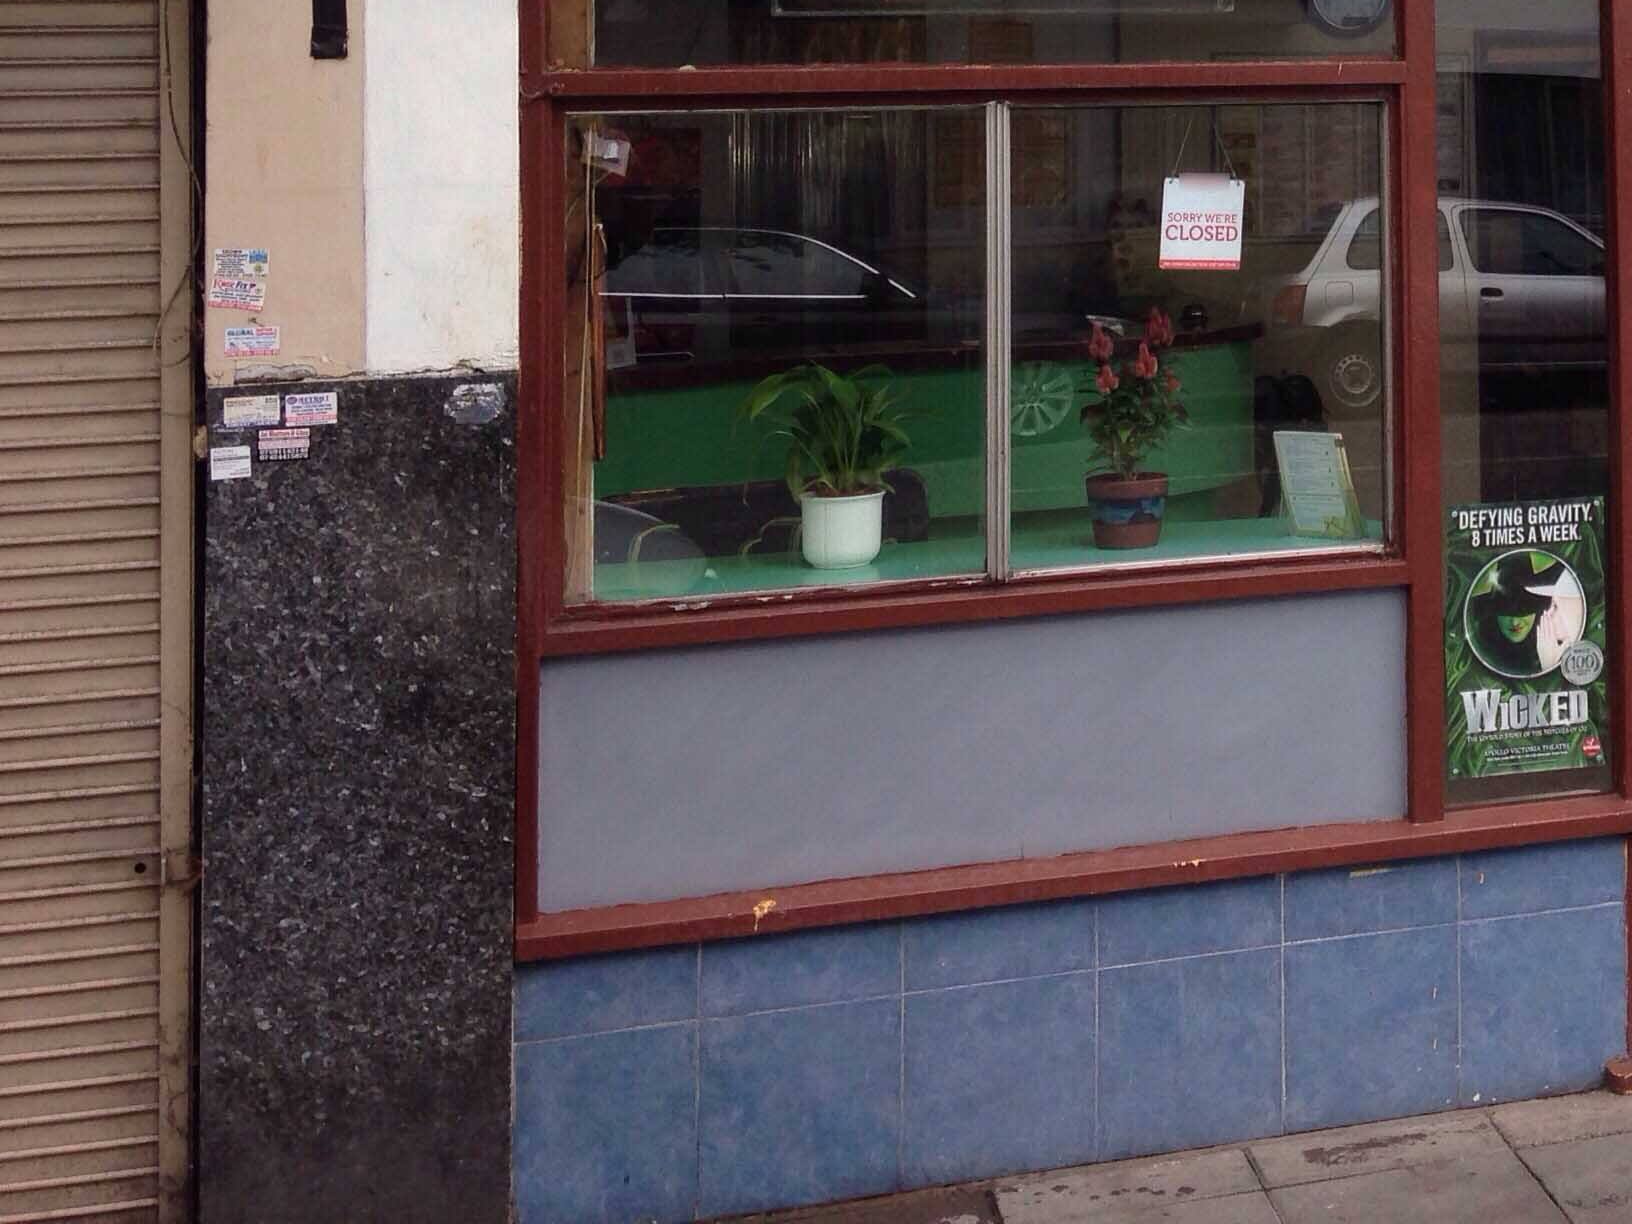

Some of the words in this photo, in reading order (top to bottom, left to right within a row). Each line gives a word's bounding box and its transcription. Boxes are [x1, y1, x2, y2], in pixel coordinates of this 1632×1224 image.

[1168, 212, 1202, 223] SORRY
[1165, 224, 1238, 242] CLOSED
[1458, 507, 1524, 530] DEFYING
[1472, 529, 1481, 547] 8
[1483, 527, 1525, 546] TIMES
[1527, 526, 1538, 544] A
